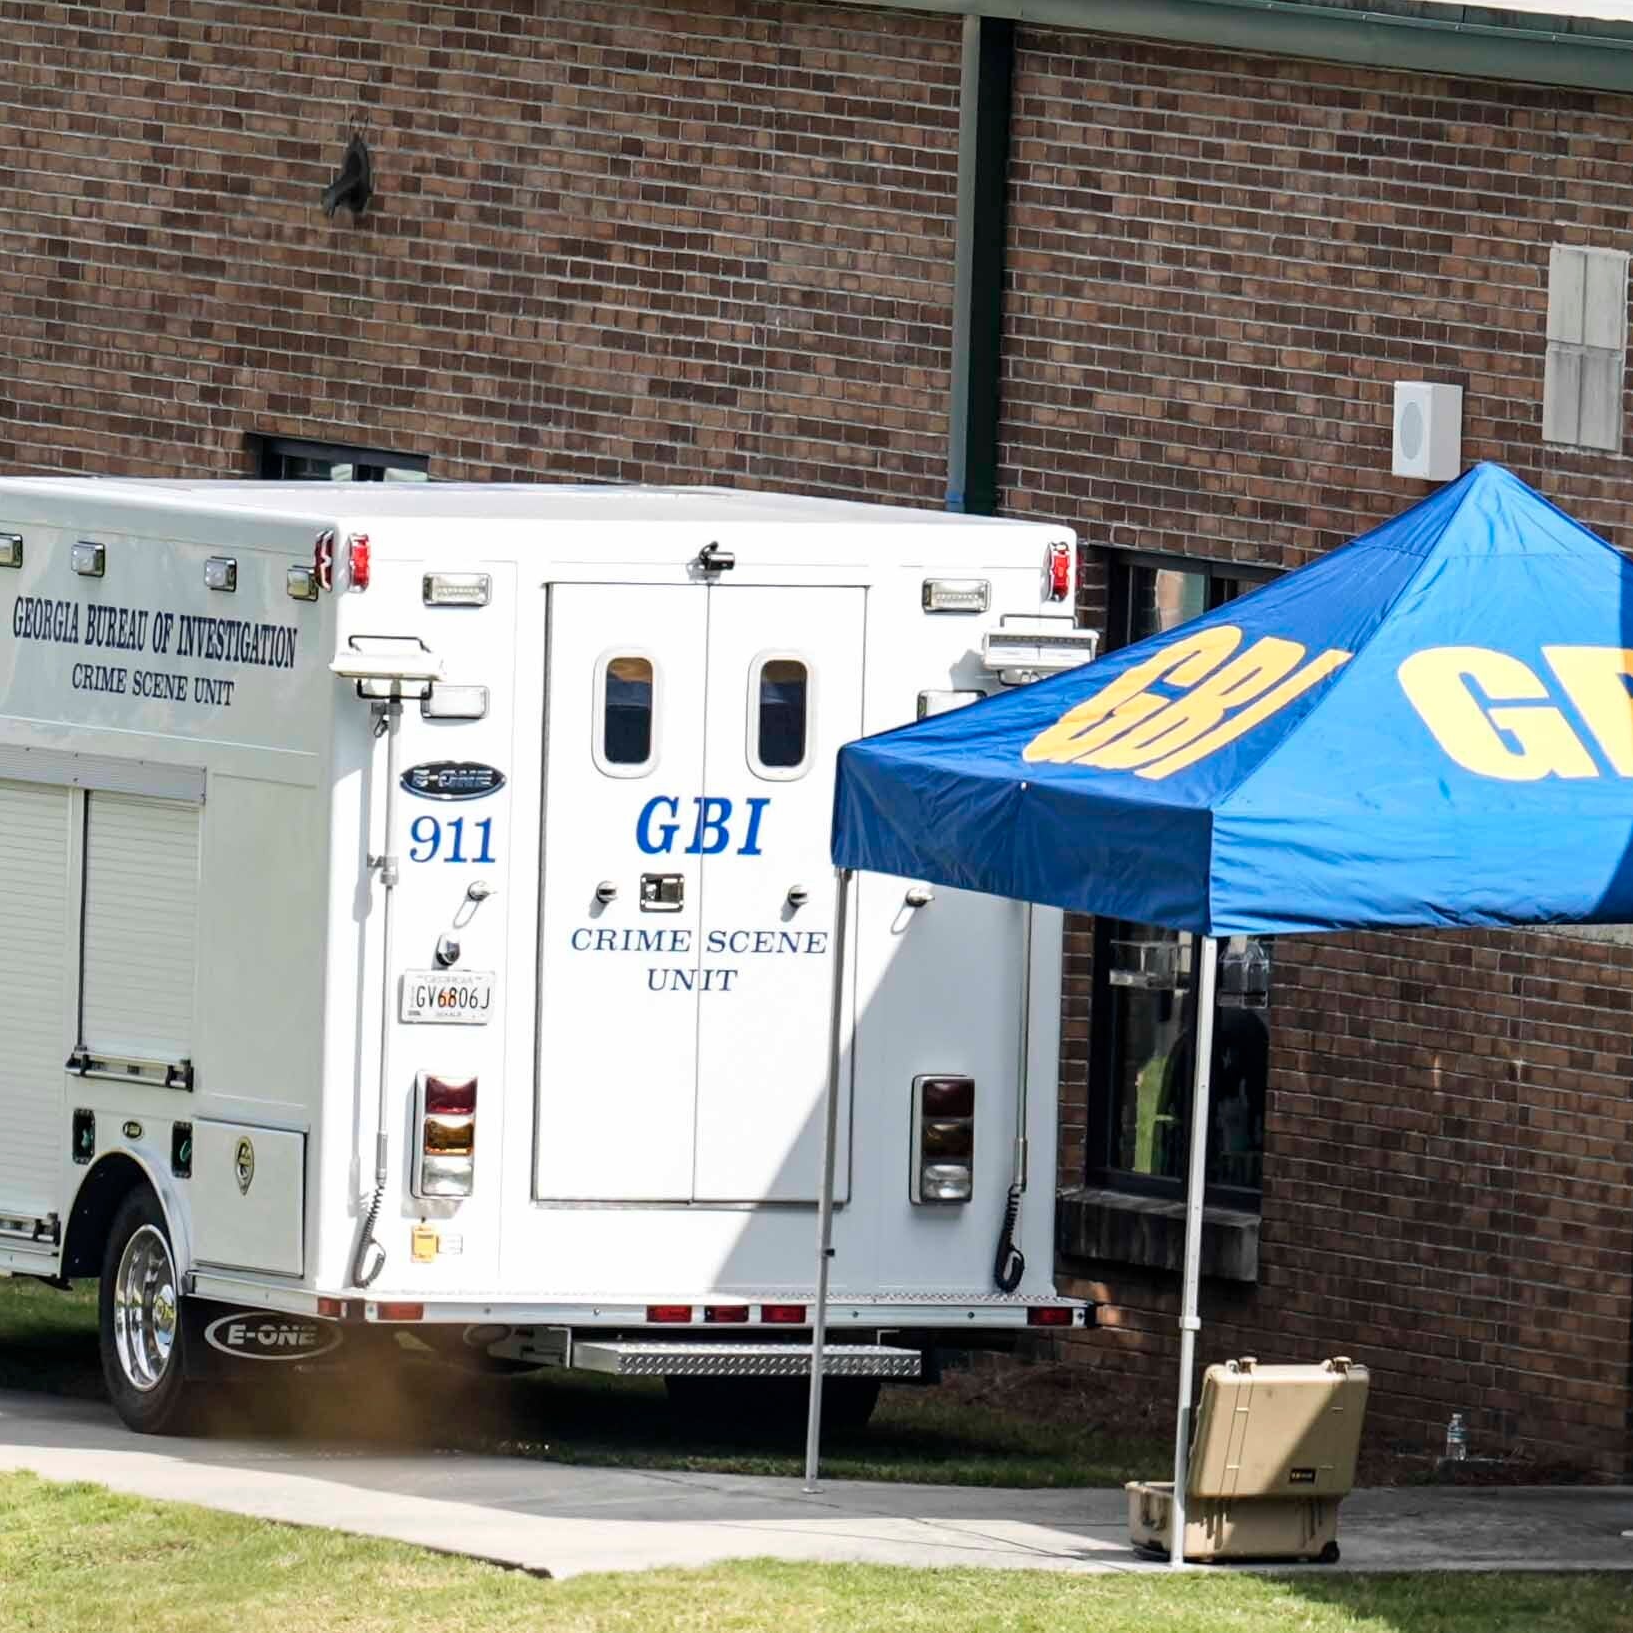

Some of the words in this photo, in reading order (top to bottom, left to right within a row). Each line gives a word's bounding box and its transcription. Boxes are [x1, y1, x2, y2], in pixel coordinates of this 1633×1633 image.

[13, 596, 79, 644] GEORGIA
[85, 604, 148, 652] BUREAU
[152, 611, 174, 654] OF
[176, 614, 298, 668] INVESTIGATION
[72, 662, 127, 695] CRIME
[132, 670, 188, 702] SCENE
[194, 677, 235, 706] UNIT
[1022, 624, 1353, 780] GBI
[409, 815, 496, 863] 911
[635, 795, 771, 856] GBI
[570, 928, 692, 952] CRIME
[706, 930, 828, 954] SCENE
[416, 984, 490, 1009] GV6806J
[647, 968, 738, 991] UNIT
[228, 1324, 318, 1345] E-ONE
